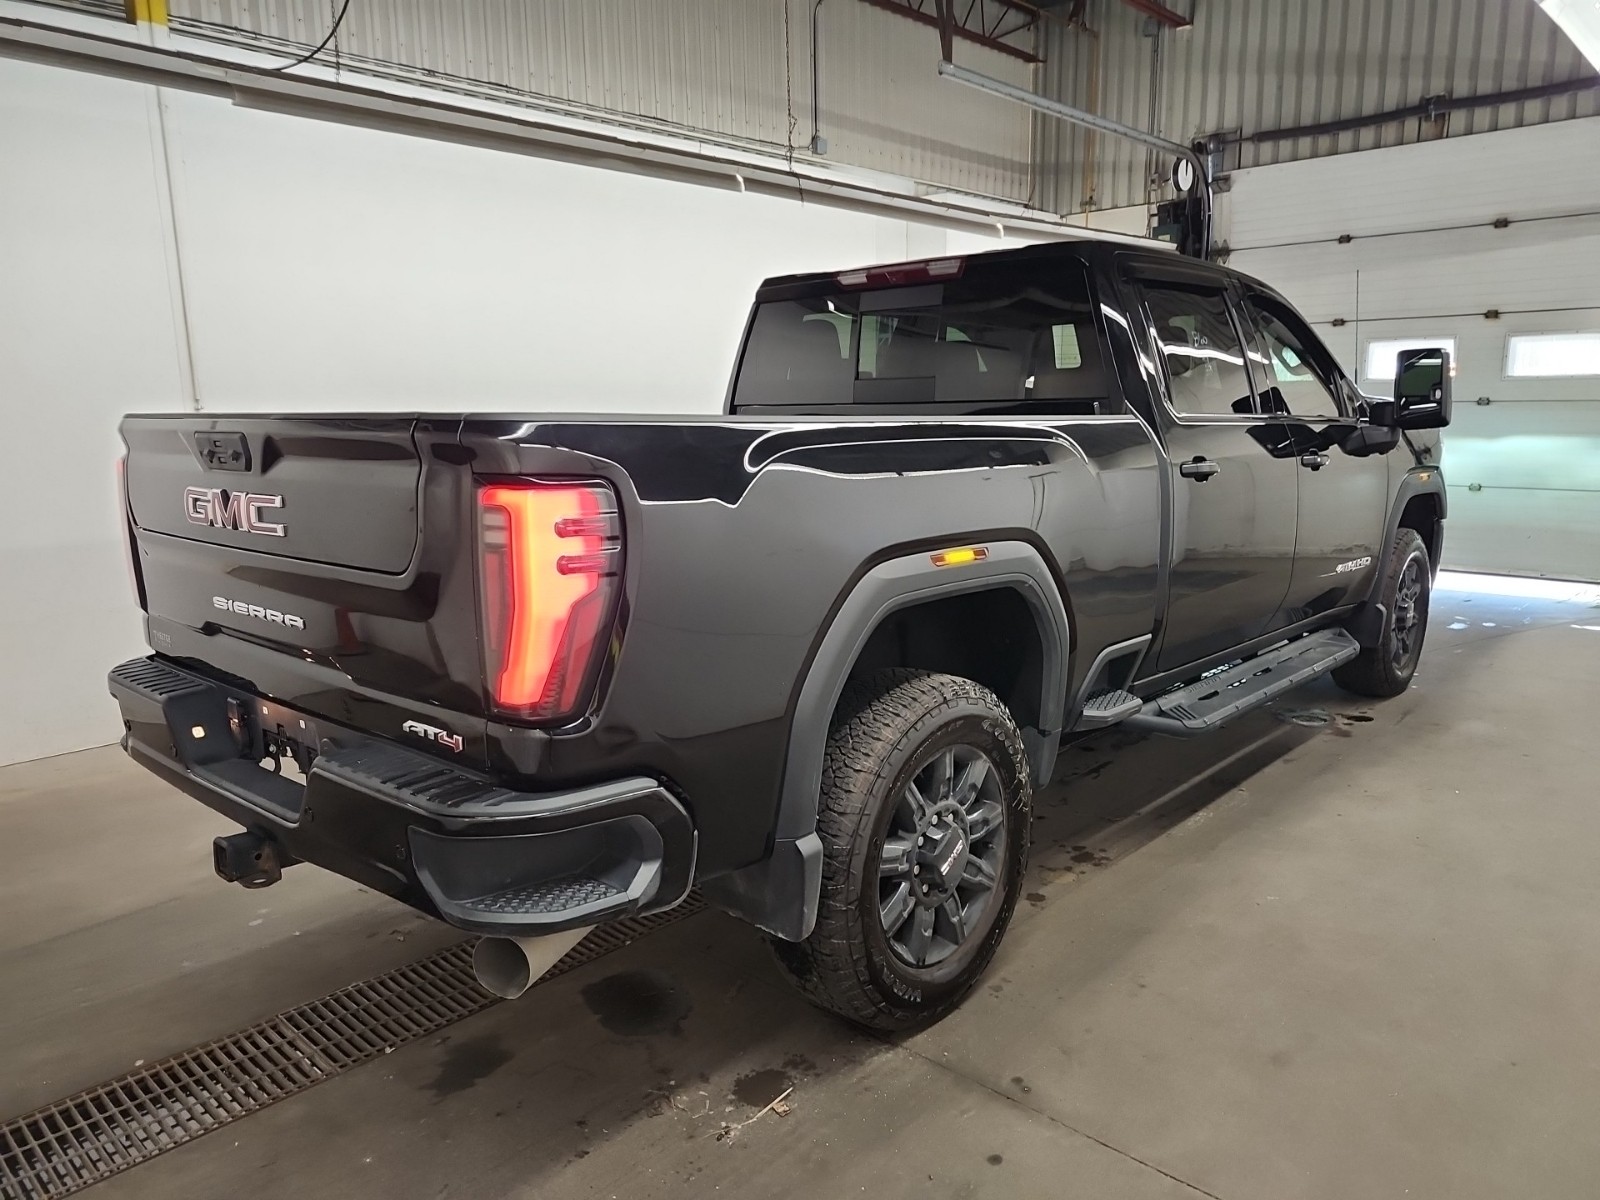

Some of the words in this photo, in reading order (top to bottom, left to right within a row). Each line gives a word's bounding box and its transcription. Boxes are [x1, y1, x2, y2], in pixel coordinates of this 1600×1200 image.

[184, 486, 286, 537] GMC
[212, 596, 306, 631] SIERRA
[402, 719, 463, 753] AT4
